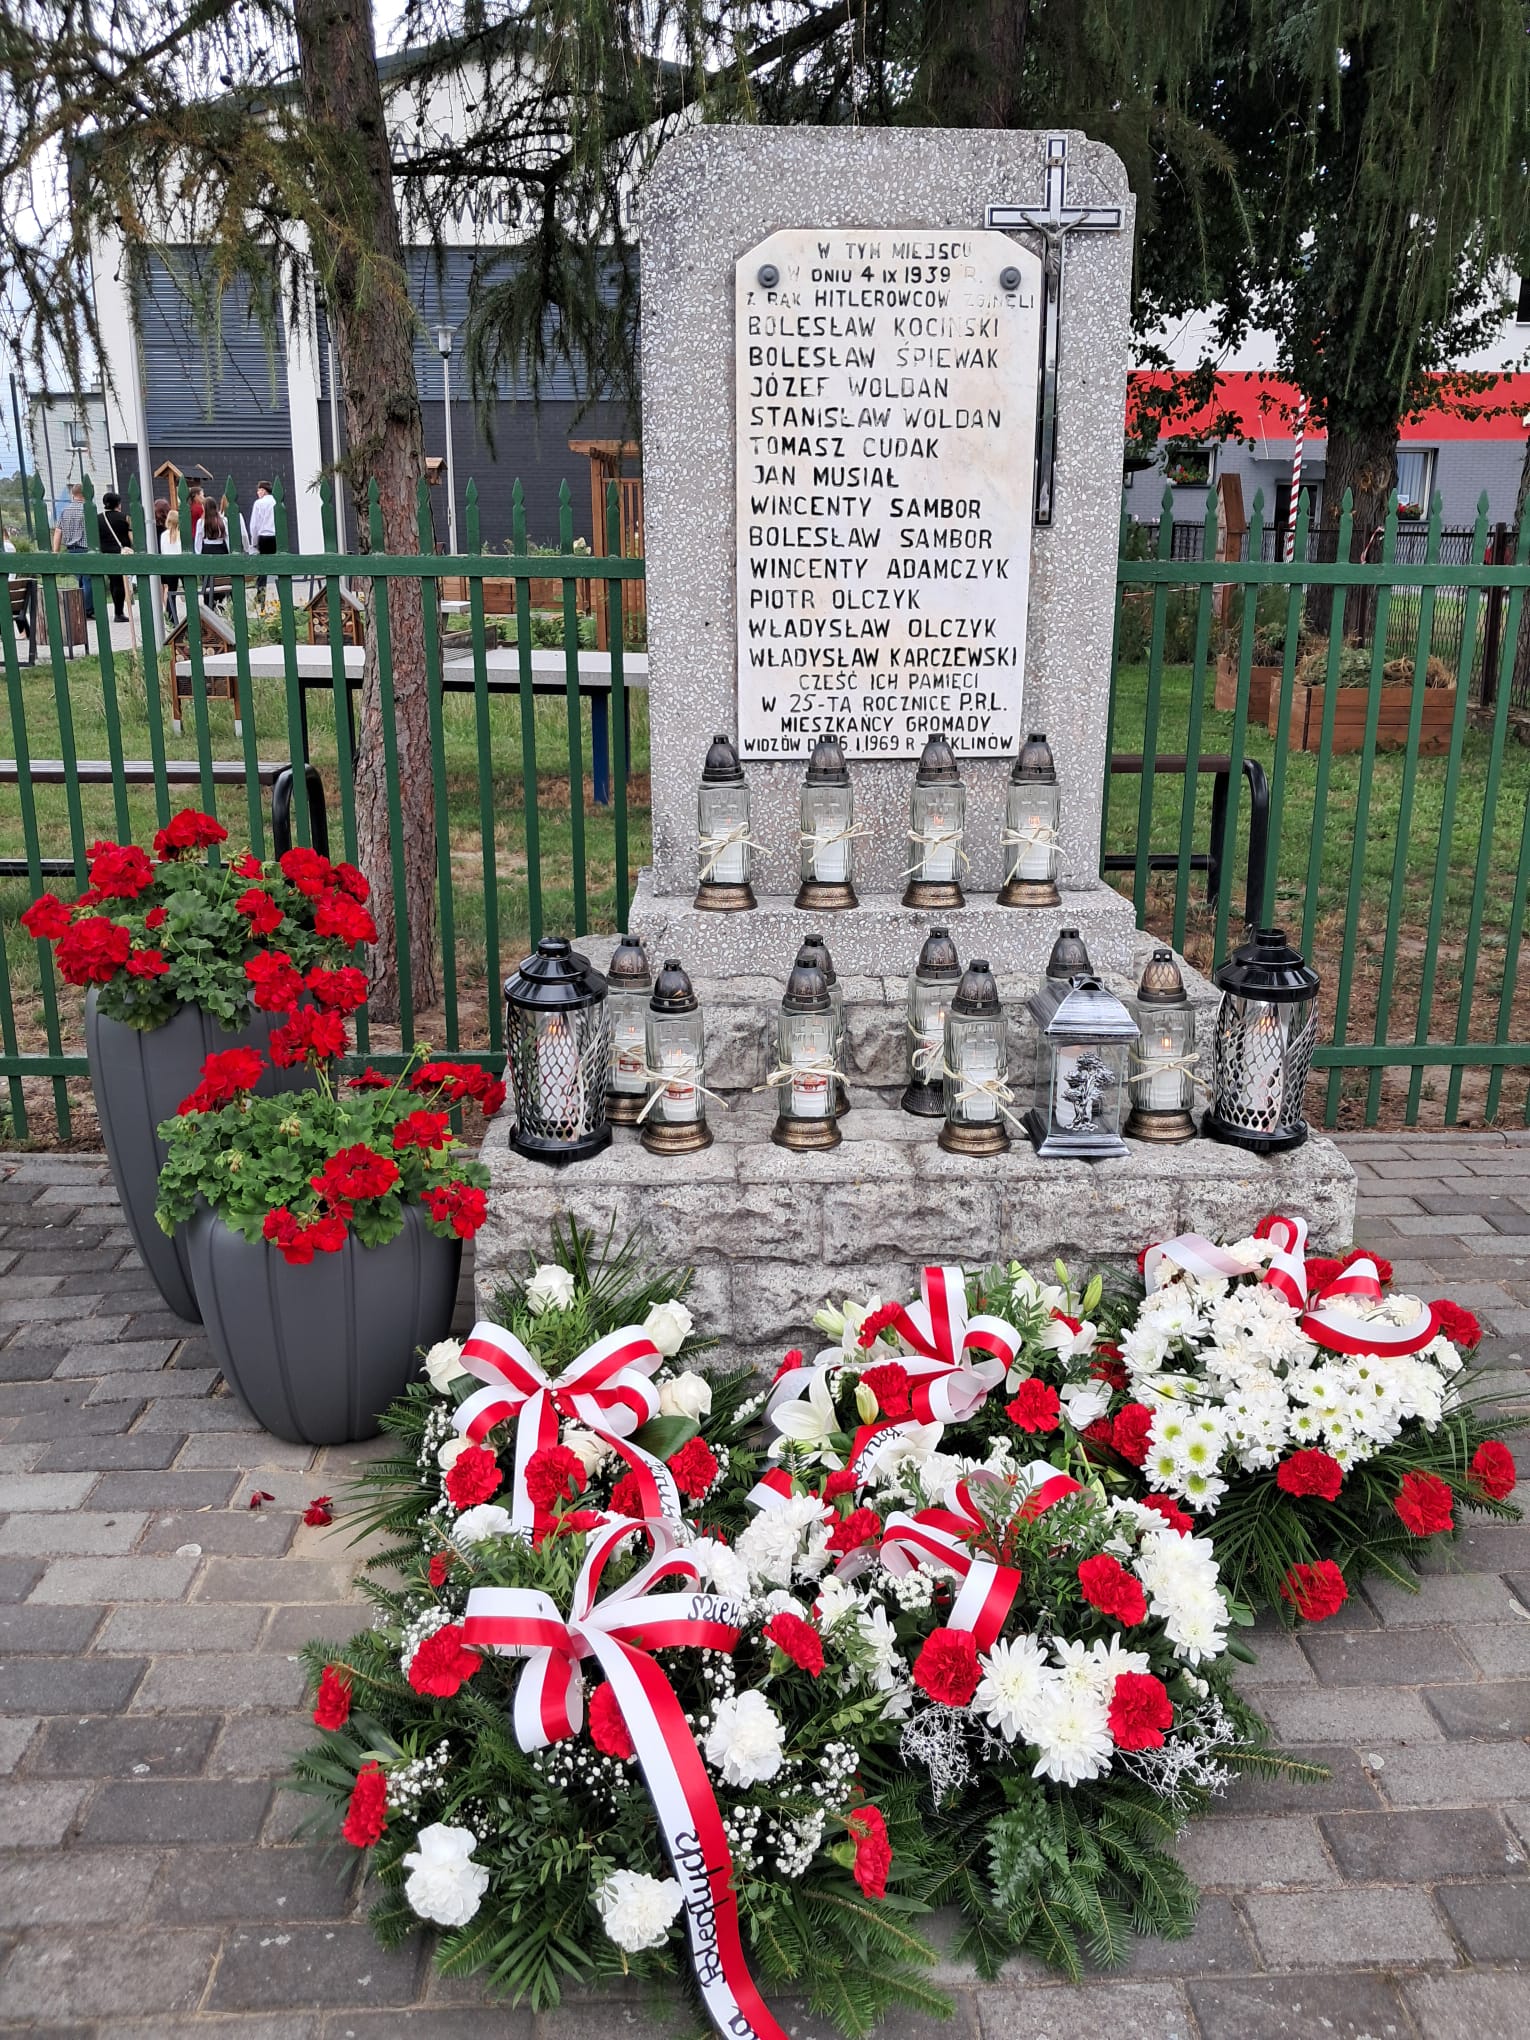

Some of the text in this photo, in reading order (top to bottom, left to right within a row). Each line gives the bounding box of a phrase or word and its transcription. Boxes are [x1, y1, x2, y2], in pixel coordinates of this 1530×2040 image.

[818, 243, 830, 259] W
[812, 269, 852, 283] DNIU
[861, 267, 875, 281] 4
[883, 270, 896, 282] IX
[905, 266, 951, 283] 1939
[749, 316, 875, 337] BOLESŁAW
[749, 342, 998, 368] BOLESŁAW ŚPIEWAK
[750, 372, 948, 398] JÓZEF WOLDAN
[750, 406, 1000, 428] STANISŁAW WOLDAN
[750, 436, 939, 458] TOMASZ CUDAK
[752, 466, 899, 488] JAN MUSIAŁ
[751, 496, 981, 519] WINCENTY SAMBOR
[750, 526, 992, 549] BOLESŁAW SAMBOR
[750, 558, 1009, 579] WINCENTY ADAMCZYK
[750, 589, 920, 610] PIOTR OLCZYK
[749, 619, 997, 639] WŁADYSŁAW OLCZYK
[750, 647, 1016, 668] WŁADYSŁAW KARCZEWSKI
[871, 674, 897, 690] ICH
[909, 673, 978, 690] PAMIĘCI
[762, 697, 776, 713] W
[863, 696, 951, 711] ROCZNICE
[906, 716, 990, 732] GROMADY
